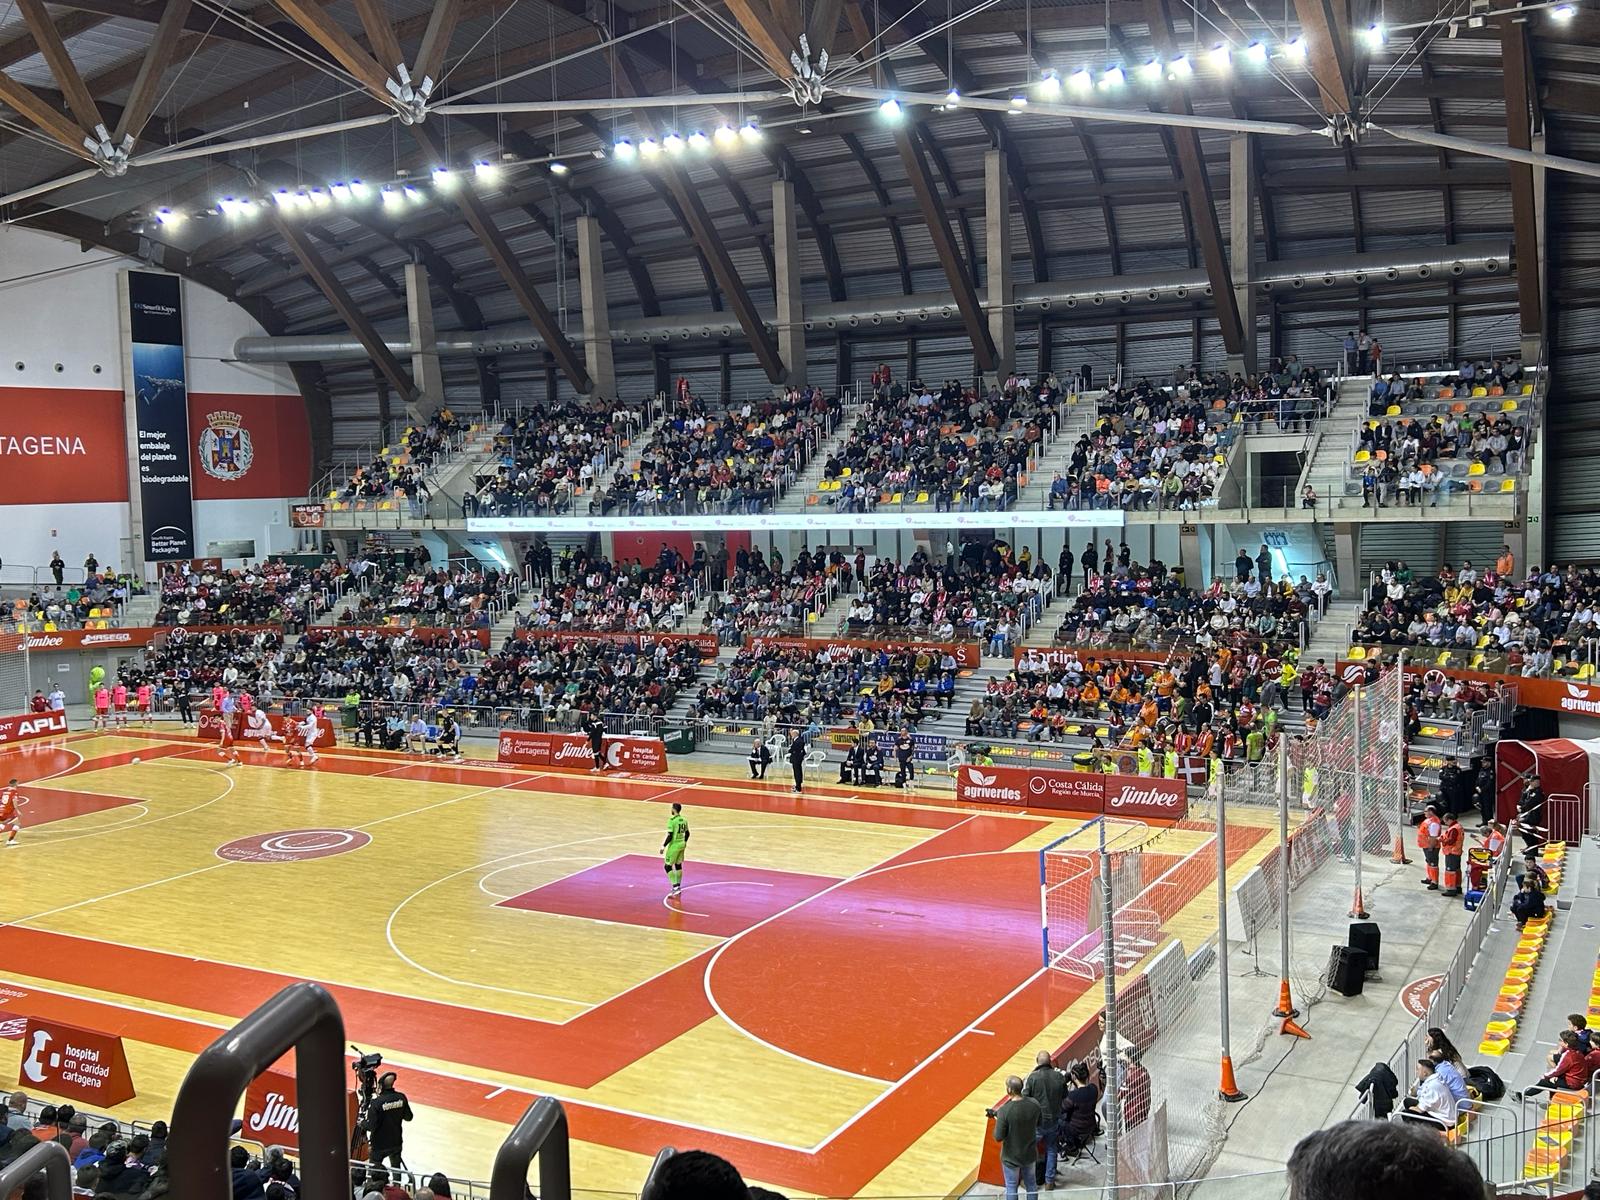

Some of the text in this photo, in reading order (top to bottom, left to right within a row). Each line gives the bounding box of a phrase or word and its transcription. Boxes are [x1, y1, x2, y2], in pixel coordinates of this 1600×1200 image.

[147, 431, 166, 440] mejor
[140, 442, 170, 451] embalaje
[152, 453, 177, 462] planeta
[141, 475, 189, 484] biodegradable
[17, 635, 63, 650] Jimbee
[694, 639, 715, 648] Cálida
[17, 715, 67, 735] APLI
[514, 746, 549, 756] Cartagena
[632, 746, 654, 754] hospital
[632, 758, 656, 766] cartagena
[643, 753, 660, 761] caridad
[1048, 779, 1104, 792] Costa Cálida
[964, 786, 1021, 800] agriverdes
[1052, 788, 1071, 796] Región
[1080, 790, 1100, 798] Murcia
[1111, 785, 1178, 807] Jimbee
[677, 823, 686, 833] 19
[65, 1043, 100, 1062] hospital
[64, 1058, 110, 1077] cm caridad
[62, 1071, 102, 1087] cartagena
